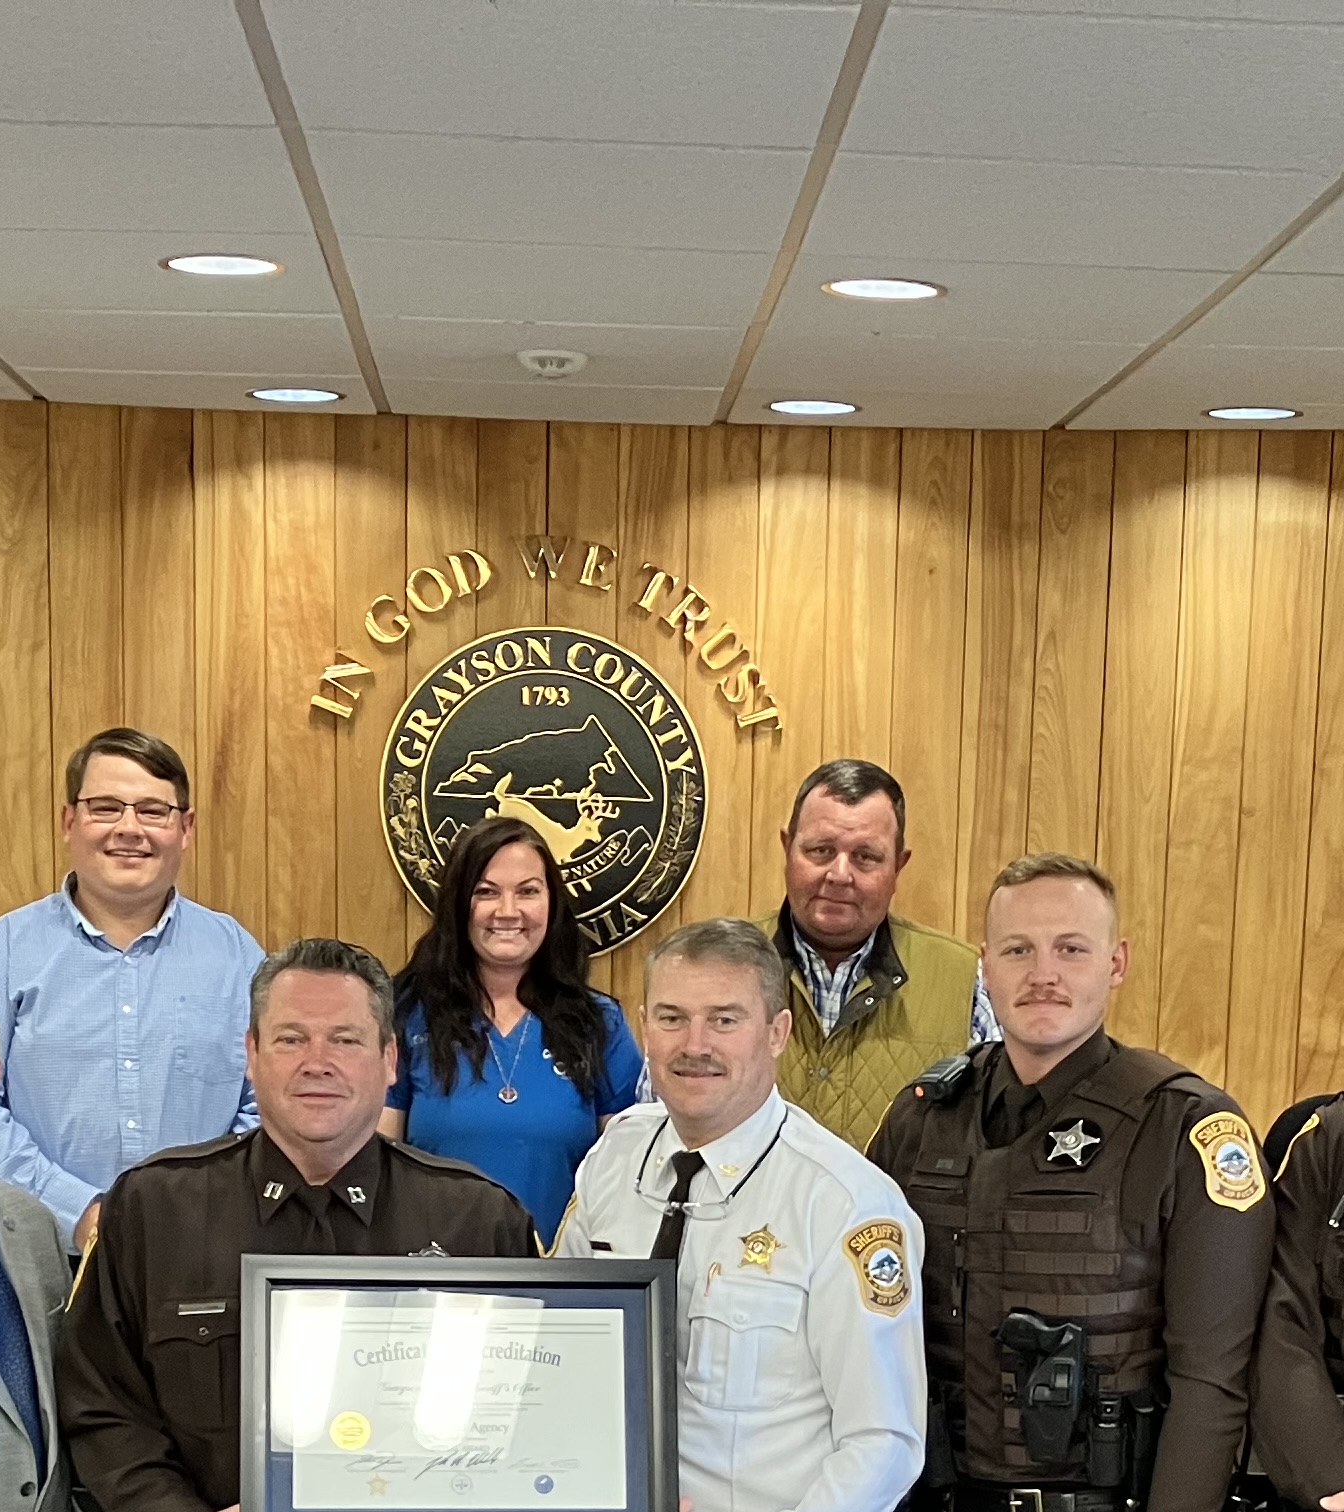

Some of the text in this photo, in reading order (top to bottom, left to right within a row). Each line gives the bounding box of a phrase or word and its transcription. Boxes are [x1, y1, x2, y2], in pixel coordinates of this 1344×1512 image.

[311, 535, 783, 729] IN GOD WE TRUST
[395, 636, 697, 775] GRAYSON COUNTY
[520, 685, 570, 707] 1793
[570, 839, 621, 880] NATURE
[353, 1341, 561, 1367] Certifica creditation
[469, 1421, 510, 1435] Agency
